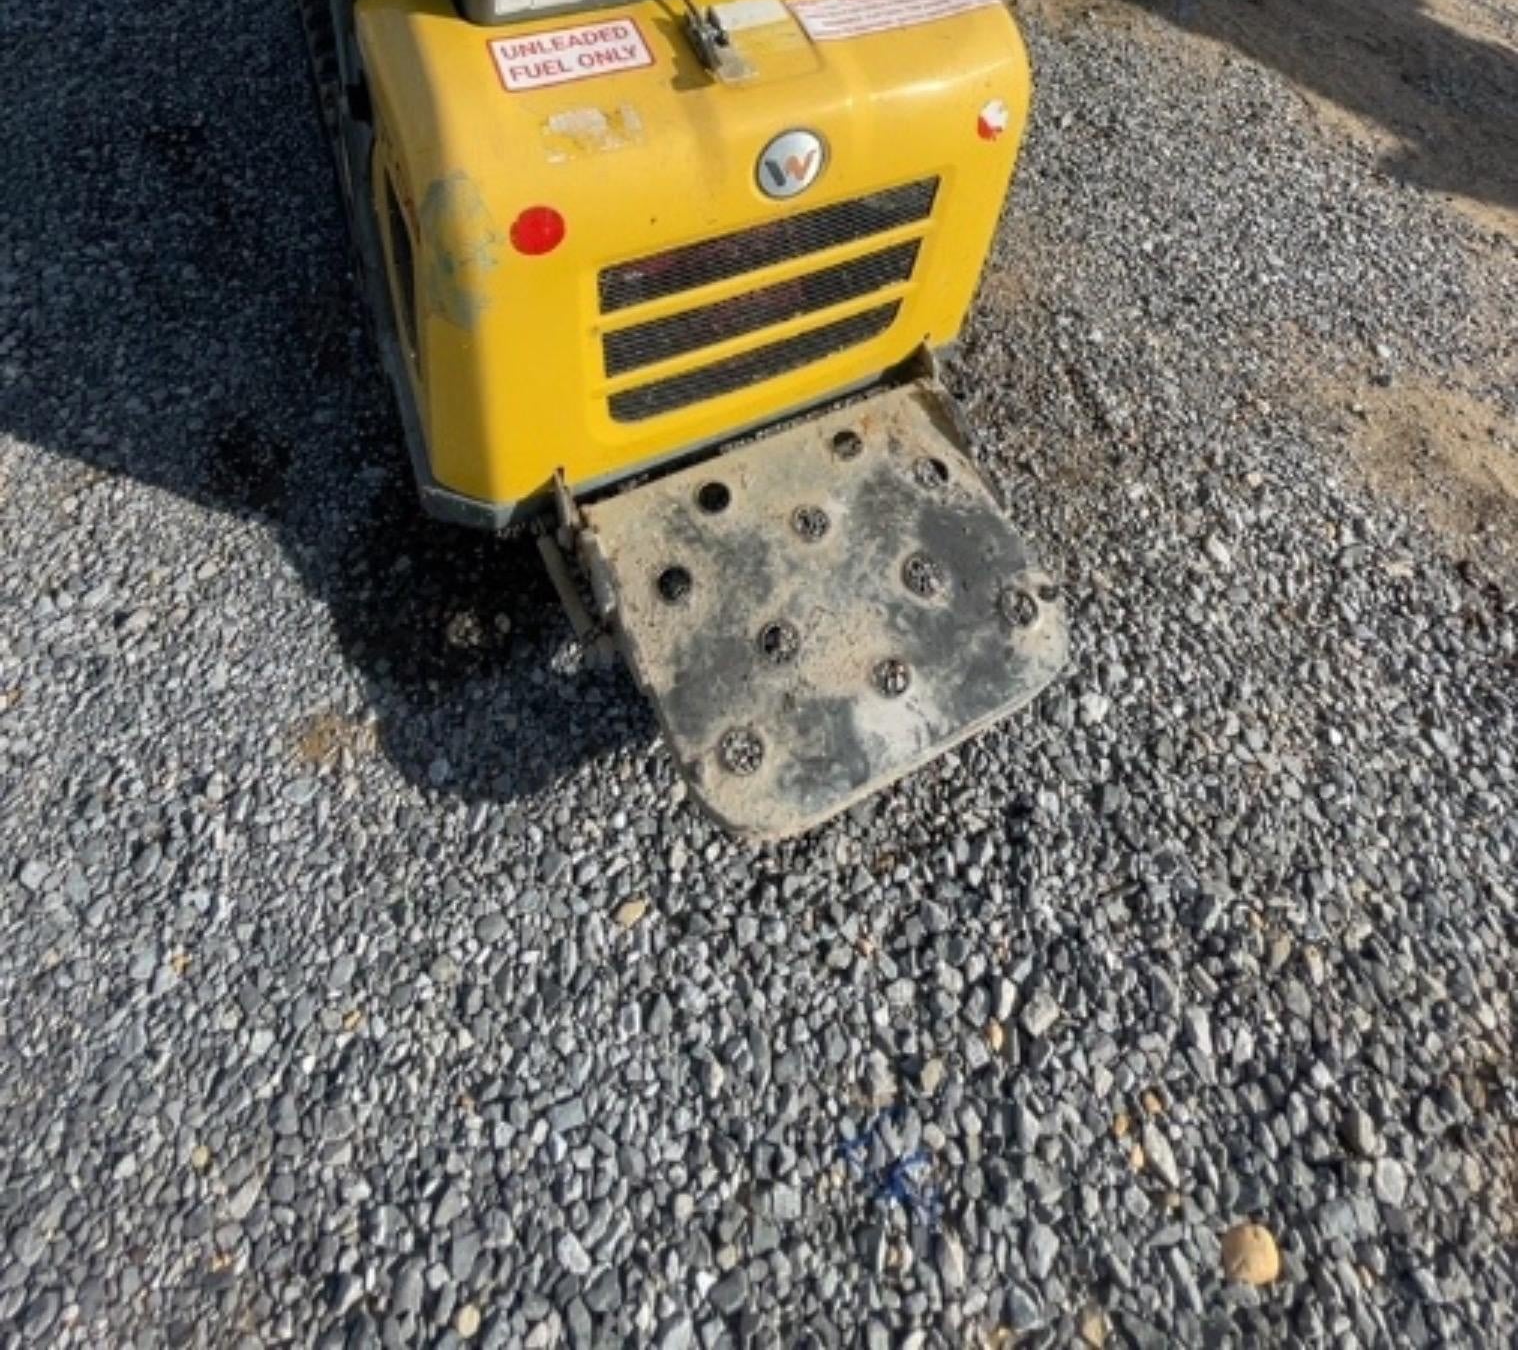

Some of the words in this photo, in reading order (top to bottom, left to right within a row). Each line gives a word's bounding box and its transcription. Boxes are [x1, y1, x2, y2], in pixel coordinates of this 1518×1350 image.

[499, 24, 630, 61] UNLEADED
[508, 58, 573, 82] FUEL
[577, 43, 639, 69] ONLY
